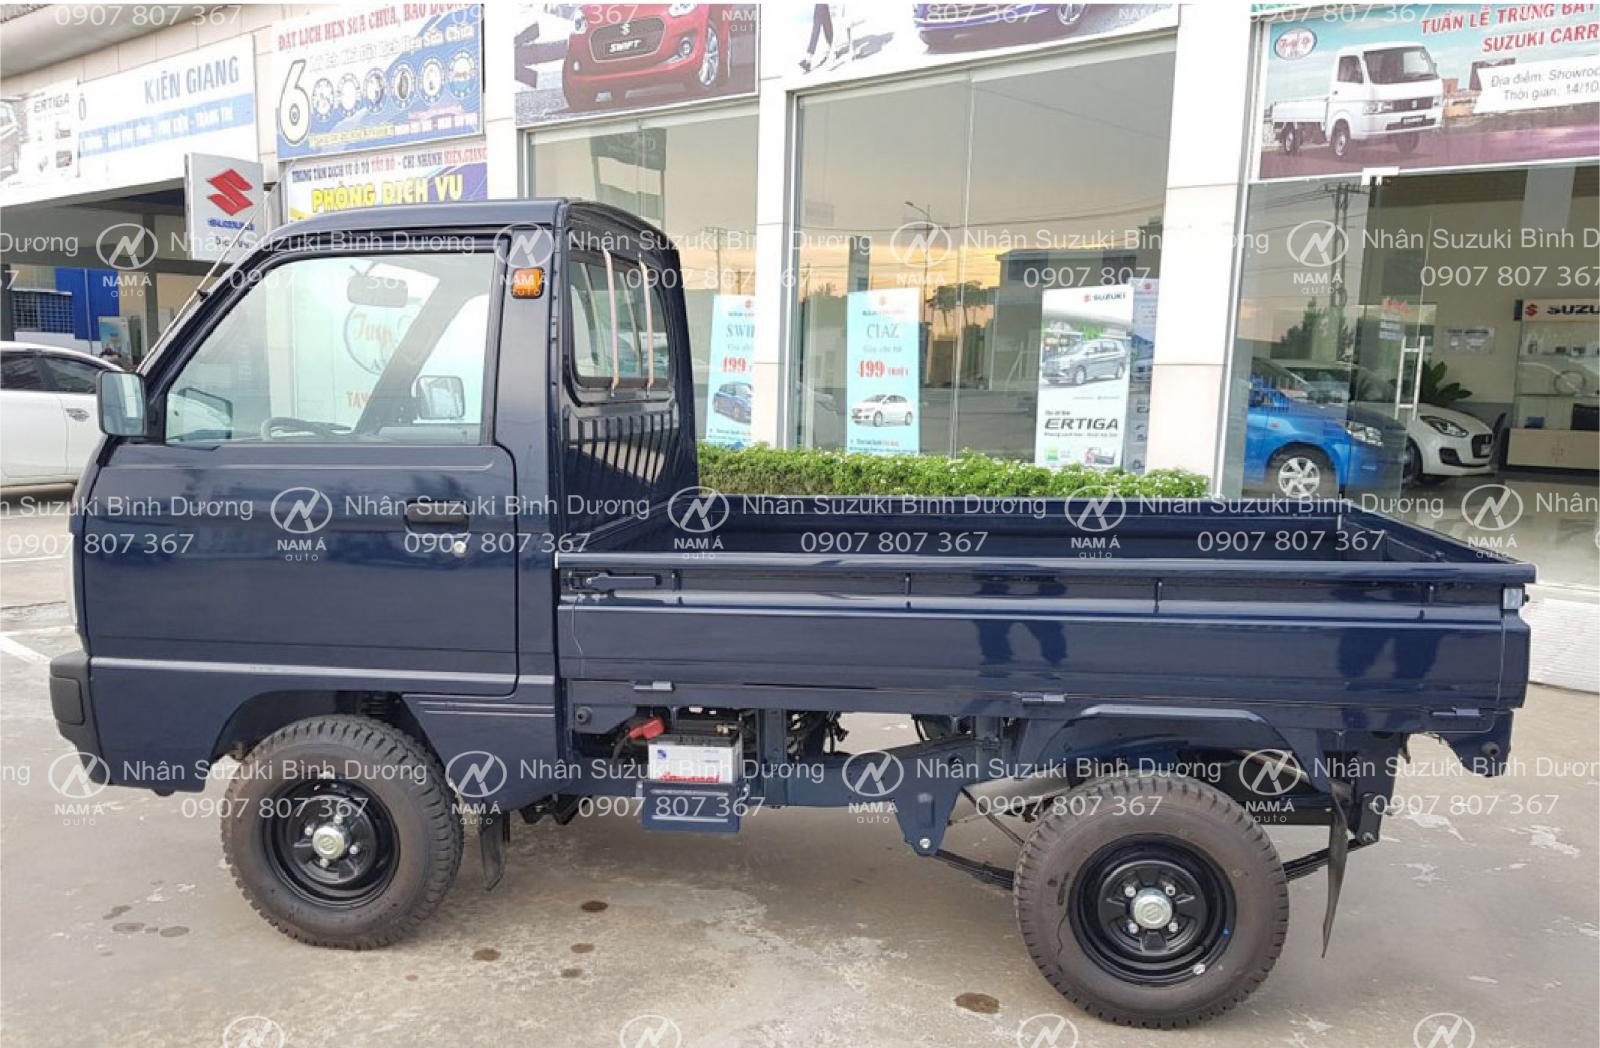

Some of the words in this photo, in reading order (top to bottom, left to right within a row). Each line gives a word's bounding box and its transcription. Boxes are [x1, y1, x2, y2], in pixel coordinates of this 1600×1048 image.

[1483, 31, 1545, 53] SUZUKI
[144, 71, 181, 104] KIÊN
[185, 56, 240, 95] GIANG
[34, 94, 70, 114] ERTIGA
[280, 59, 311, 146] 6
[311, 179, 376, 213] PHÒNG
[1044, 418, 1119, 431] ERTIGA
